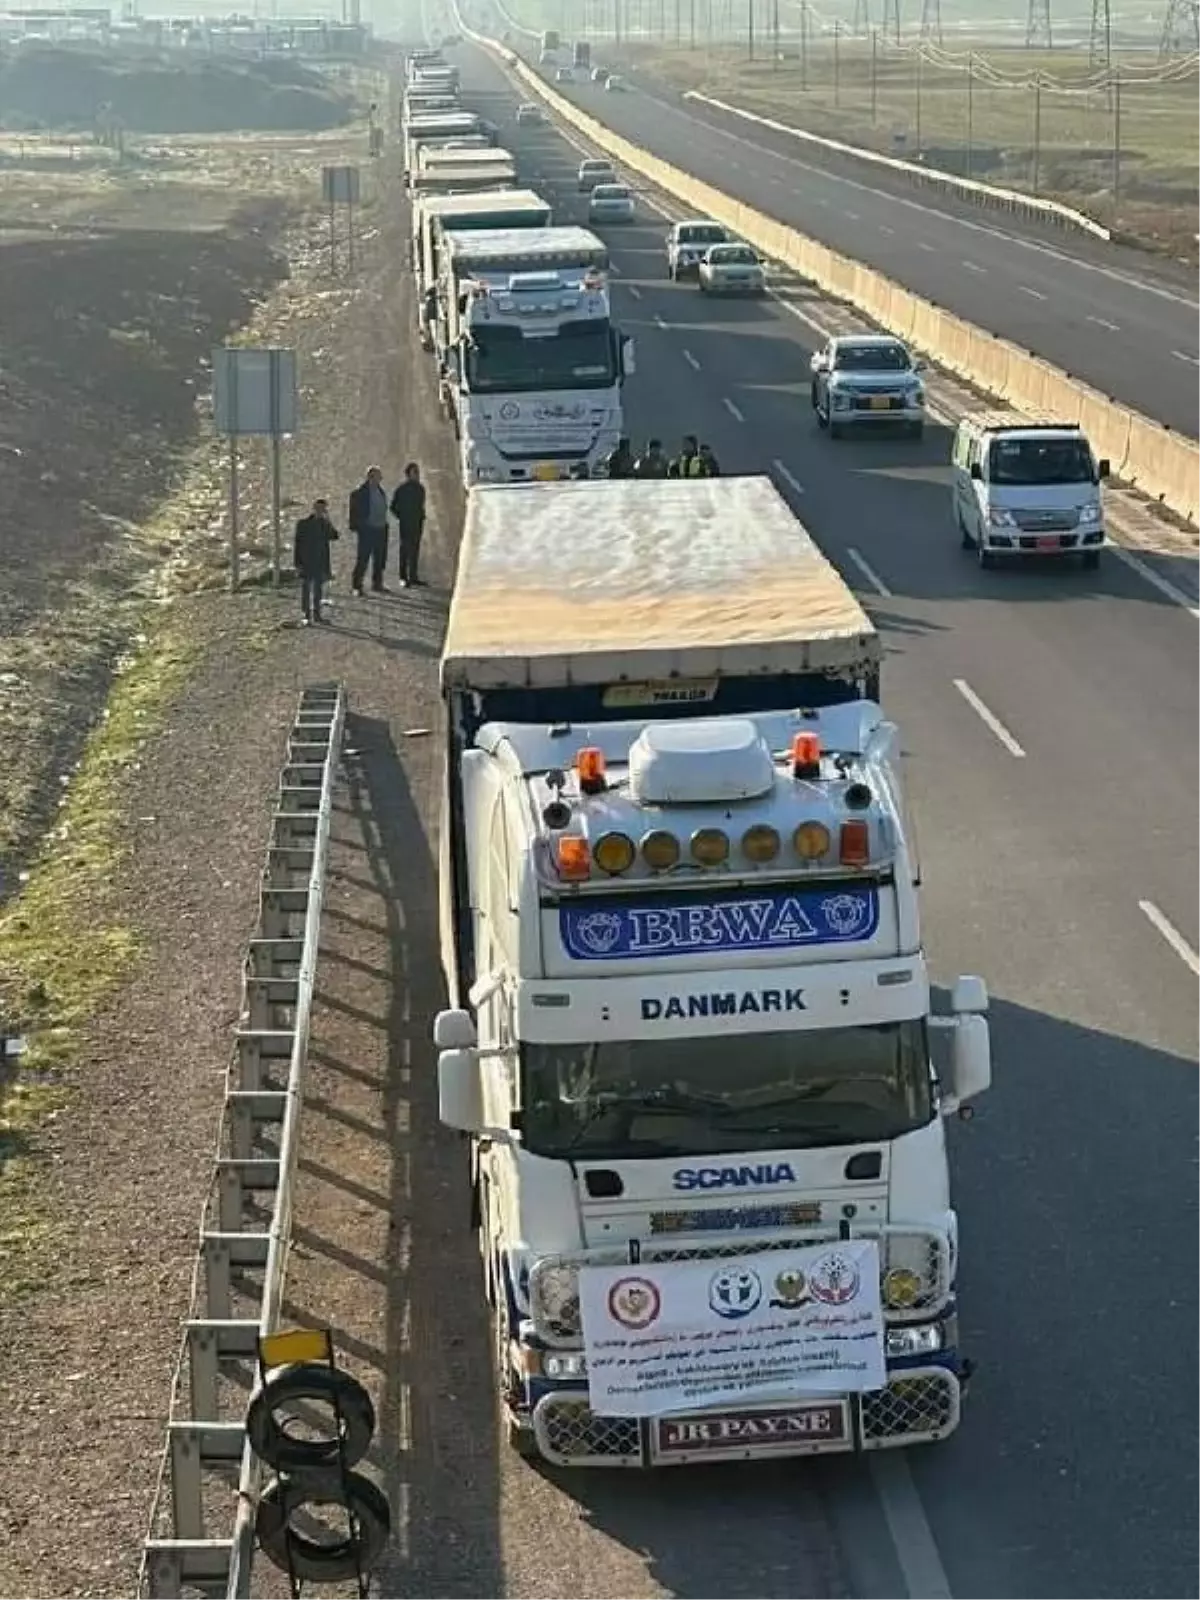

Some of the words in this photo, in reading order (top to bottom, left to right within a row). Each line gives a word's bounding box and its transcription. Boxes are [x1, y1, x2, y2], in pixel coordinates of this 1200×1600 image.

[628, 898, 817, 950] BRWA
[641, 988, 807, 1020] DANMARK
[672, 1163, 797, 1191] SCANIA
[668, 1421, 710, 1445] JR
[719, 1409, 832, 1438] PAYNE
